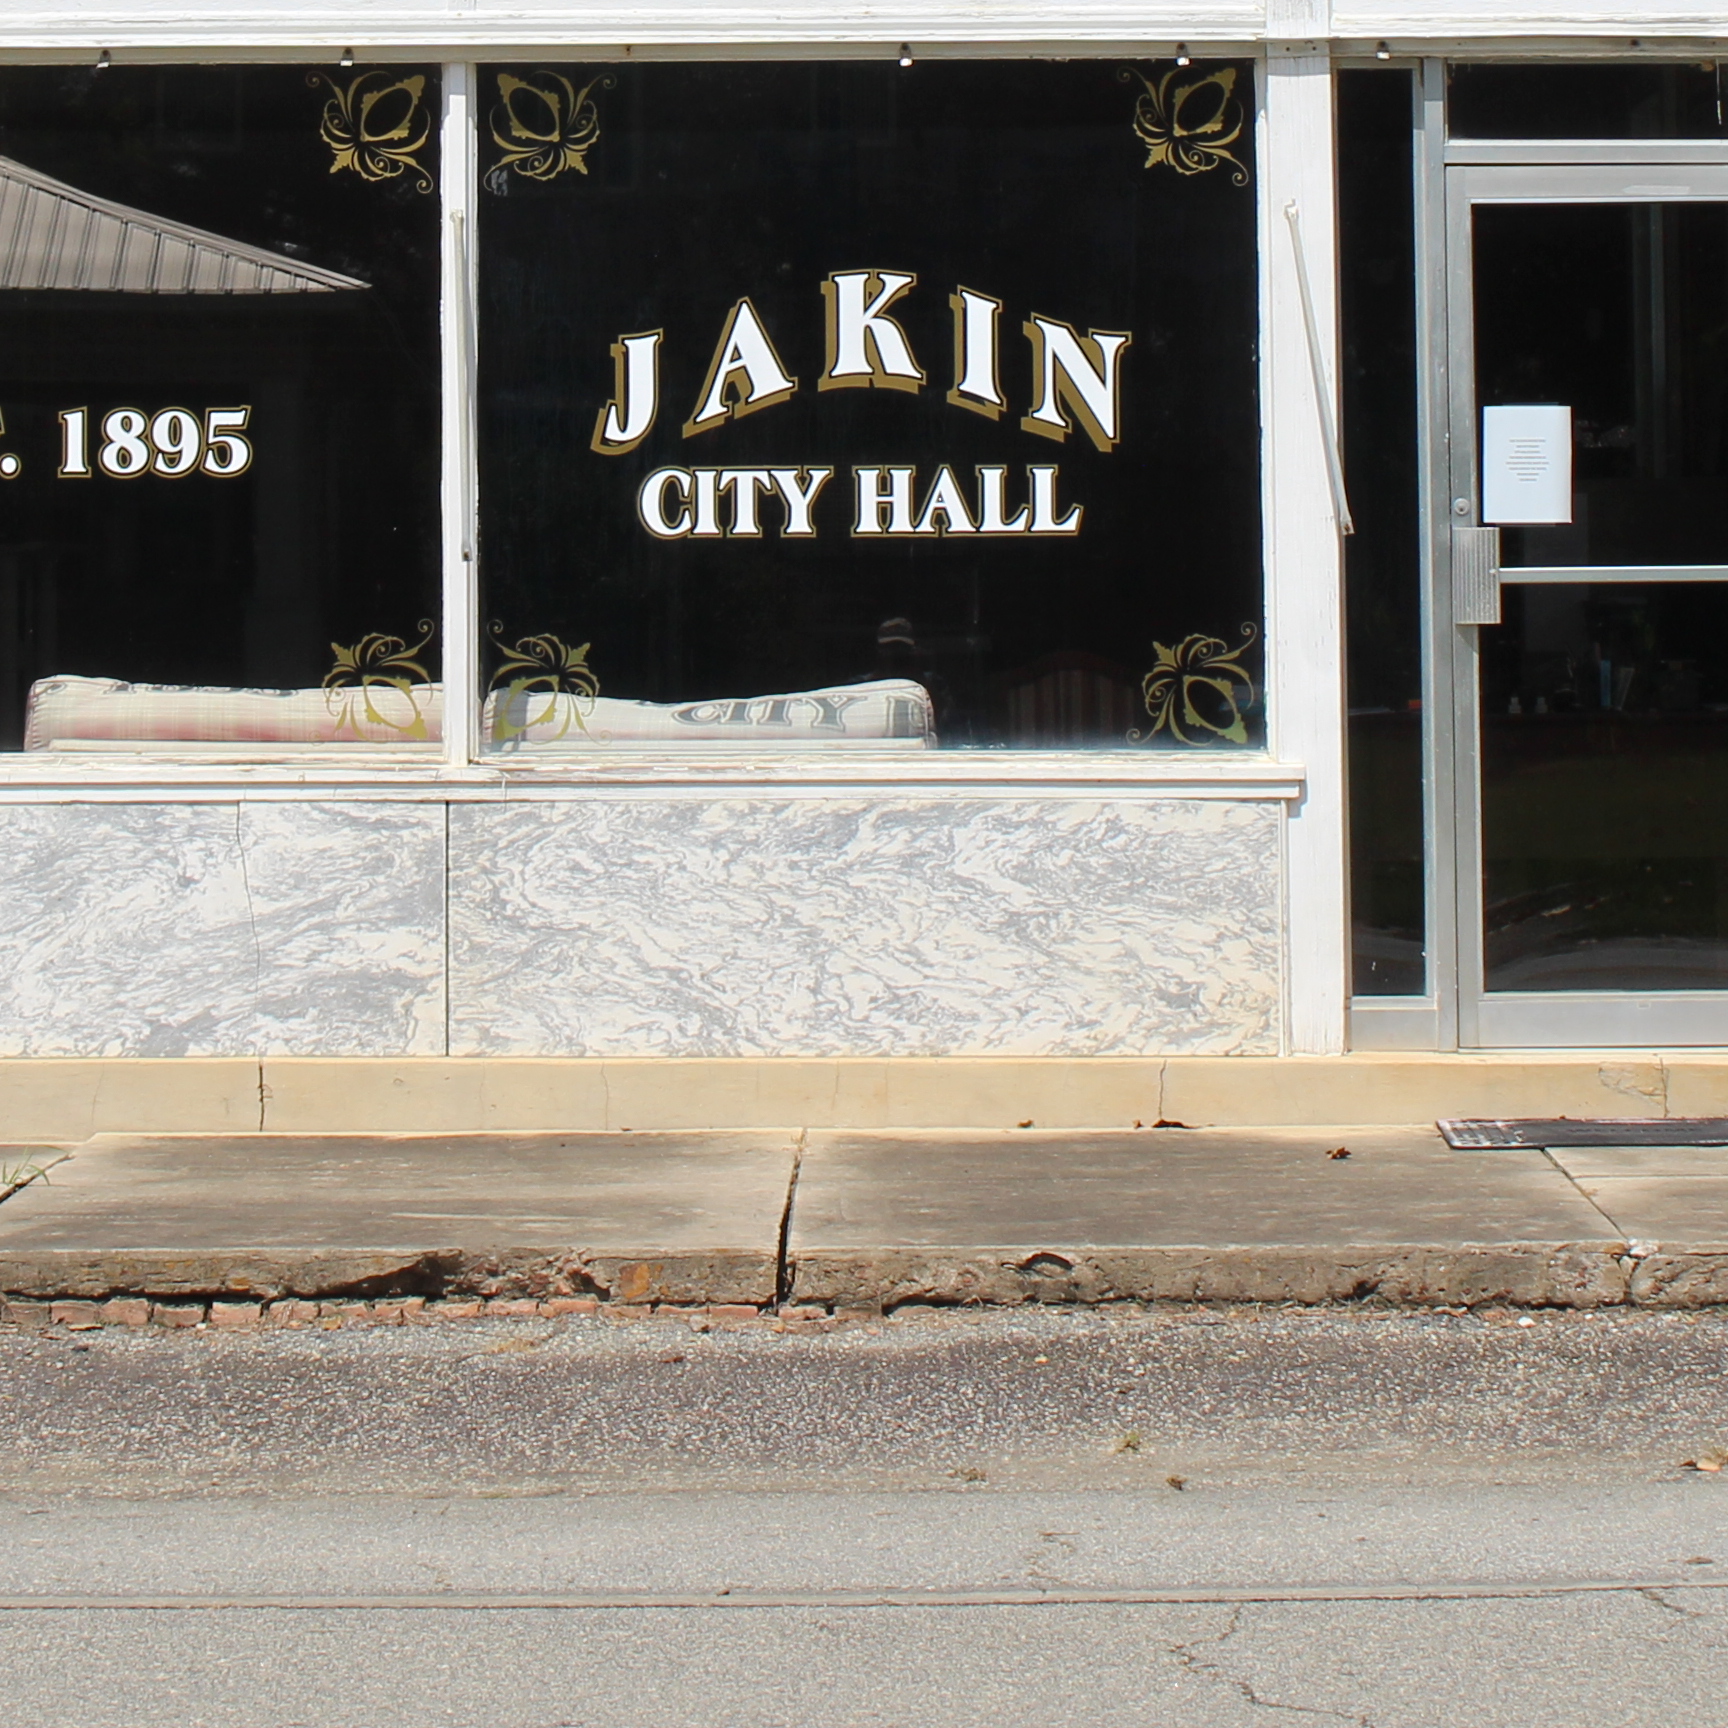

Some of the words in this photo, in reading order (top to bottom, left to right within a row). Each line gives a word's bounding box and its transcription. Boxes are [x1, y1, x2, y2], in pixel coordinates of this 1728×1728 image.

[591, 269, 1131, 455] JAKIN
[57, 406, 252, 478] 1895
[638, 464, 834, 538] CITY
[851, 464, 1083, 537] HALL
